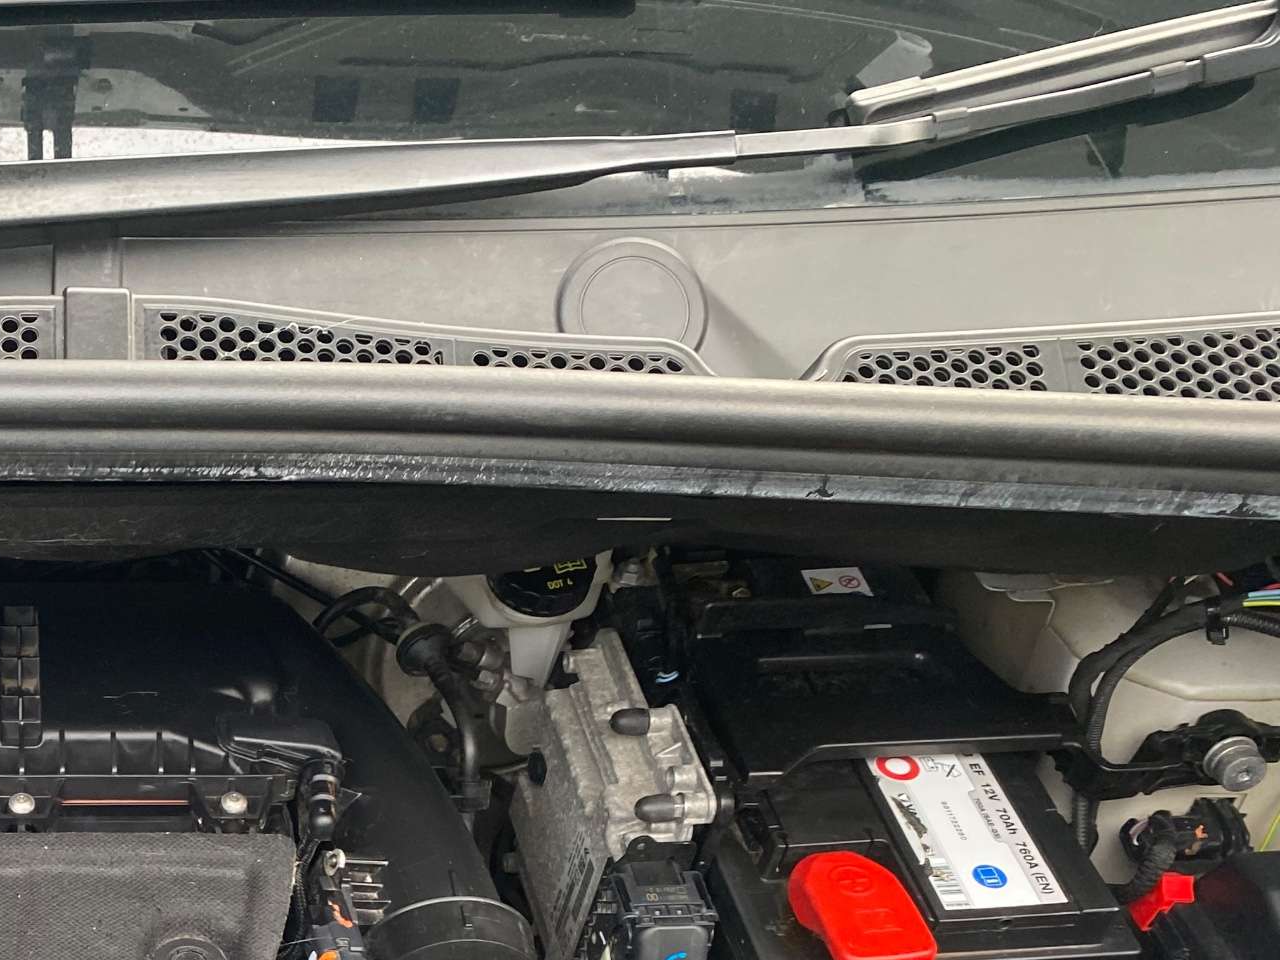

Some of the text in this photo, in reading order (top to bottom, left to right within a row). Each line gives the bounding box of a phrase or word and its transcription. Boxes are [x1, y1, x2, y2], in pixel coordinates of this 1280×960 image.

[981, 783, 1001, 802] 12V
[995, 806, 1019, 836] 70Ah
[1015, 840, 1039, 870] 760A
[1031, 871, 1056, 895] (EN)
